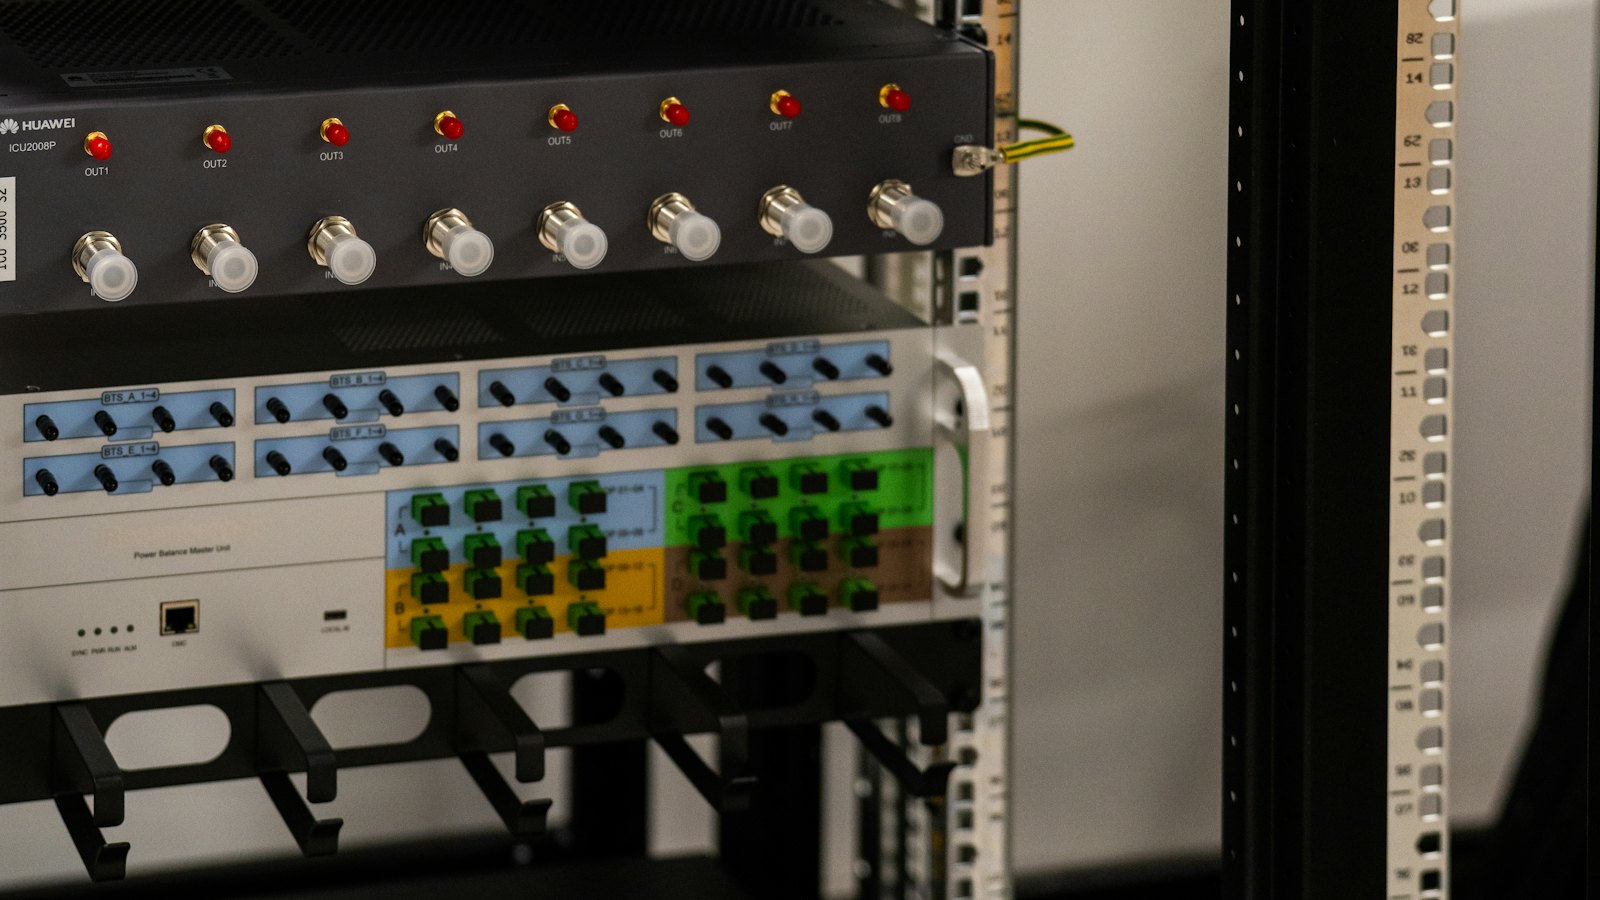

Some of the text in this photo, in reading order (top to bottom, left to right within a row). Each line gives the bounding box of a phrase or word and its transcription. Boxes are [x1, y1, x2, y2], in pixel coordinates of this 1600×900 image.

[1405, 72, 1423, 84] 14
[878, 114, 902, 124] OUT8
[22, 118, 76, 131] HUAWEI
[769, 121, 793, 131] OUT7
[659, 128, 683, 138] OUT6
[548, 136, 572, 146] OUT5
[9, 141, 57, 153] ICU2008P
[434, 143, 458, 153] OUT4
[319, 151, 344, 161] OUT3
[203, 159, 228, 169] OUT2
[84, 167, 109, 177] OUT1
[1403, 176, 1421, 189] 13
[325, 270, 337, 279] IN
[208, 279, 219, 288] IN
[1401, 283, 1419, 295] 12
[394, 523, 406, 536] A
[133, 544, 231, 559] Power Balance Master Unit
